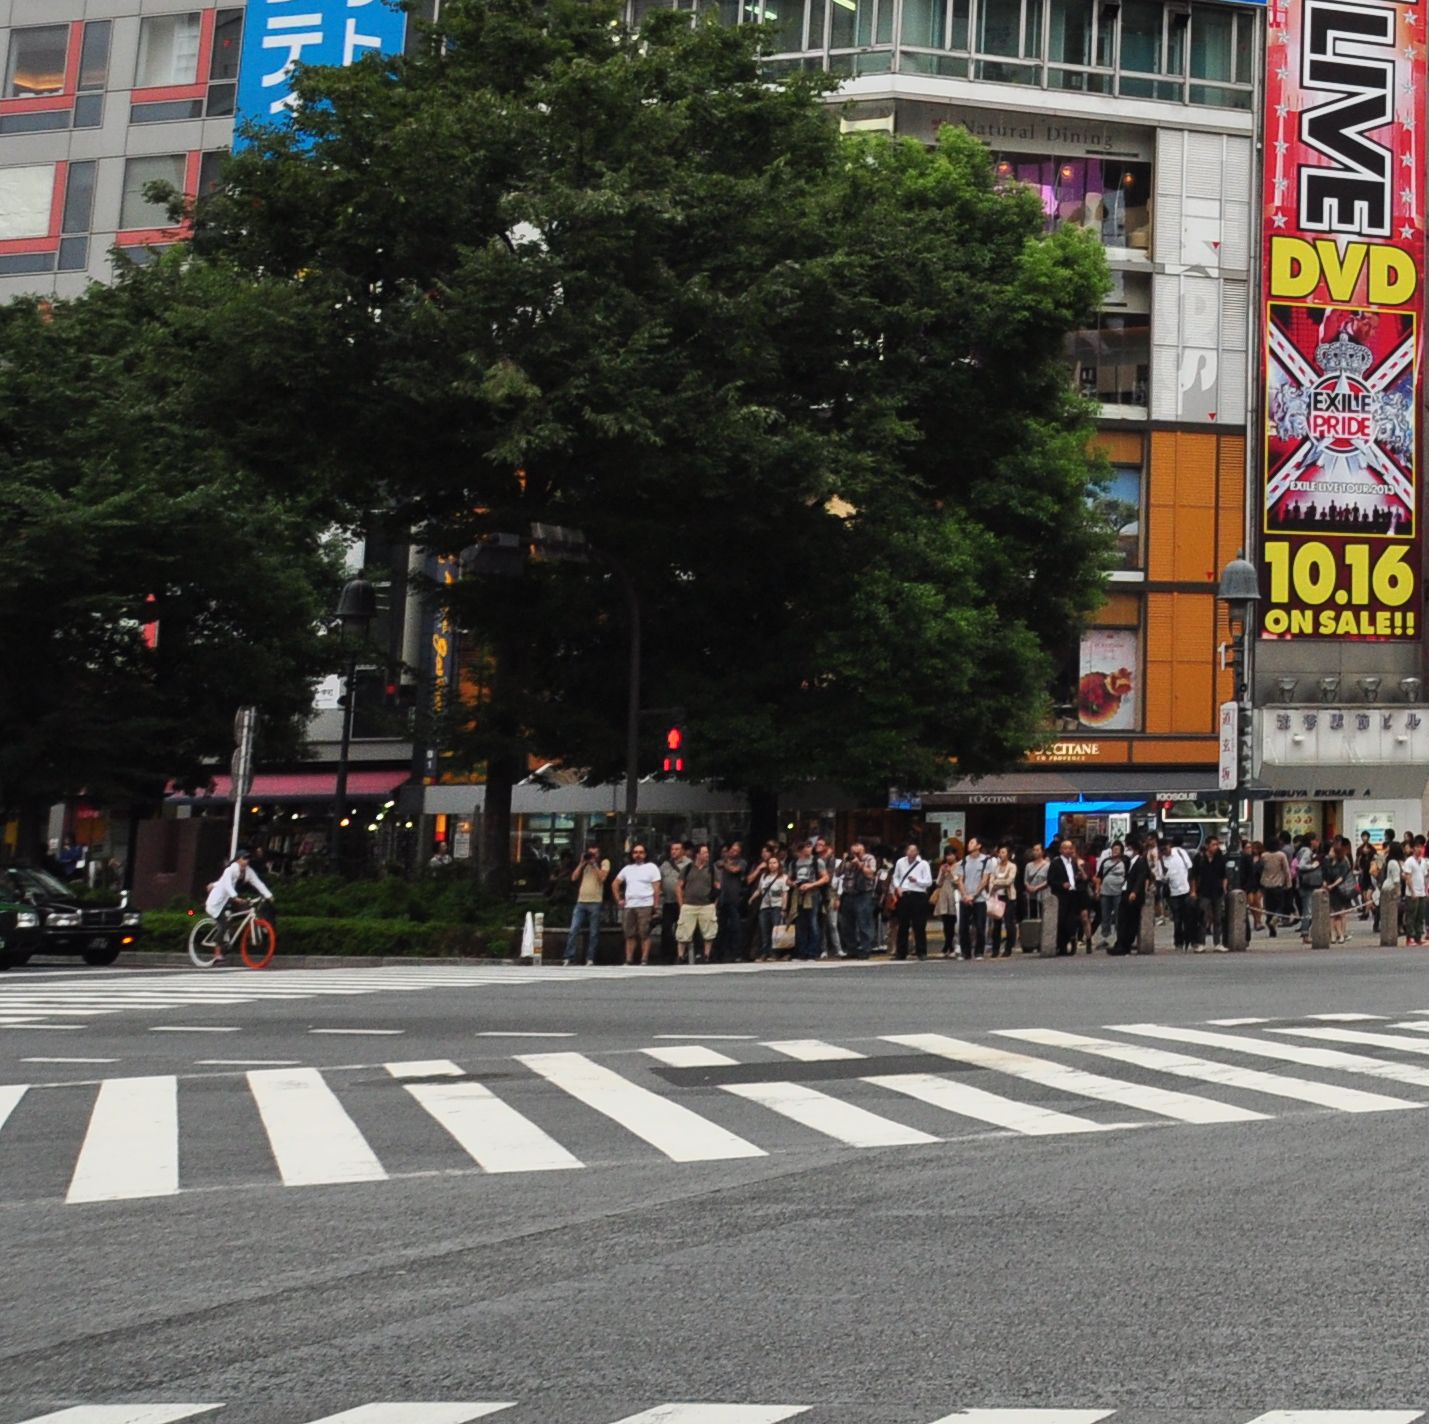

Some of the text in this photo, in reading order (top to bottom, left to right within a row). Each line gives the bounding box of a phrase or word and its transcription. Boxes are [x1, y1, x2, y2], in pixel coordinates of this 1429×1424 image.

[1046, 125, 1114, 150] Dining
[1269, 234, 1417, 307] DVD
[1312, 391, 1372, 414] EXILE
[1311, 413, 1371, 437] PRIDE
[1290, 480, 1396, 495] EXILE LIVE TOUR 2013
[1264, 541, 1415, 607] 10.16
[1264, 609, 1415, 636] ON SALE!!
